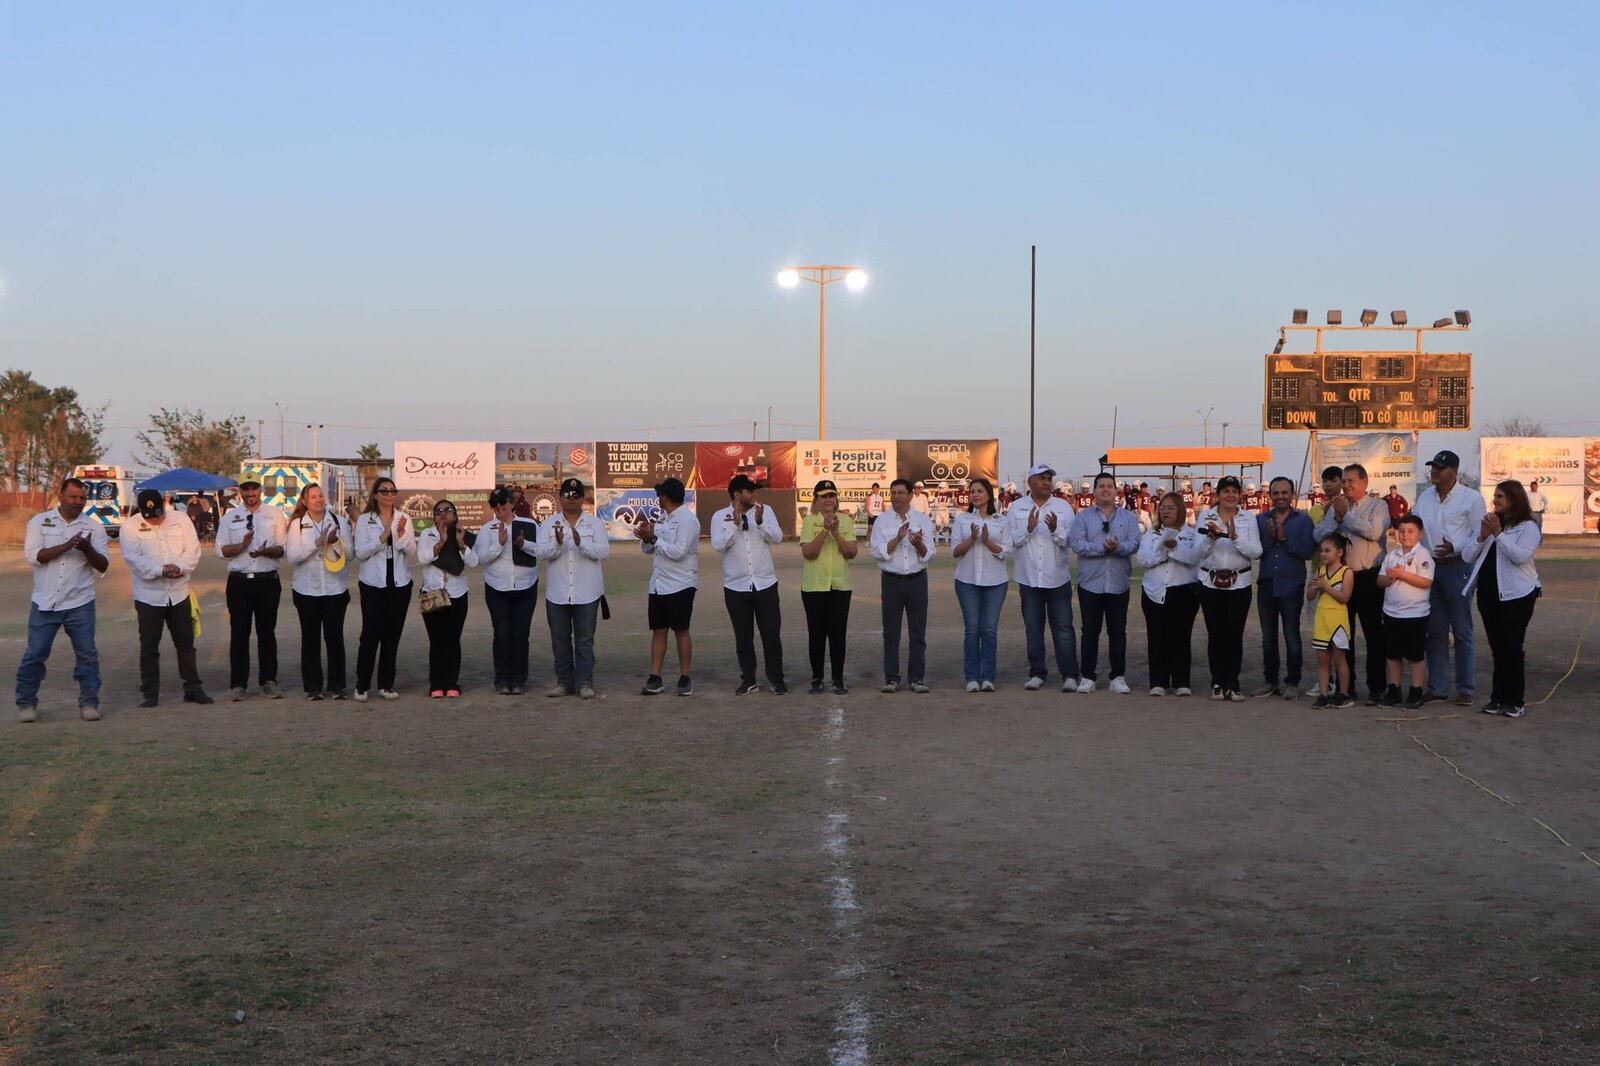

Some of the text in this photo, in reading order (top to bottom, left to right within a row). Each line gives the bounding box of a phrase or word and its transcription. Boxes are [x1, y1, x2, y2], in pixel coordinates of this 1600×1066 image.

[1322, 392, 1338, 402] TOL
[1349, 389, 1371, 402] QTR
[1399, 392, 1414, 402] TOL
[1286, 411, 1316, 424] DOWN
[1361, 411, 1390, 424] TO GO
[1396, 411, 1436, 423] BALL ON
[608, 443, 648, 452] TU EQUIPO
[928, 443, 968, 453] COAL
[507, 447, 537, 461] C & S
[608, 453, 648, 461] TU CIUDAD
[832, 451, 886, 463] Hospital
[405, 452, 479, 473] David
[608, 462, 620, 472] TU
[1516, 458, 1579, 469] de Sabinas
[958, 495, 969, 504] 66
[1080, 497, 1091, 507] 69
[1183, 493, 1193, 502] 20
